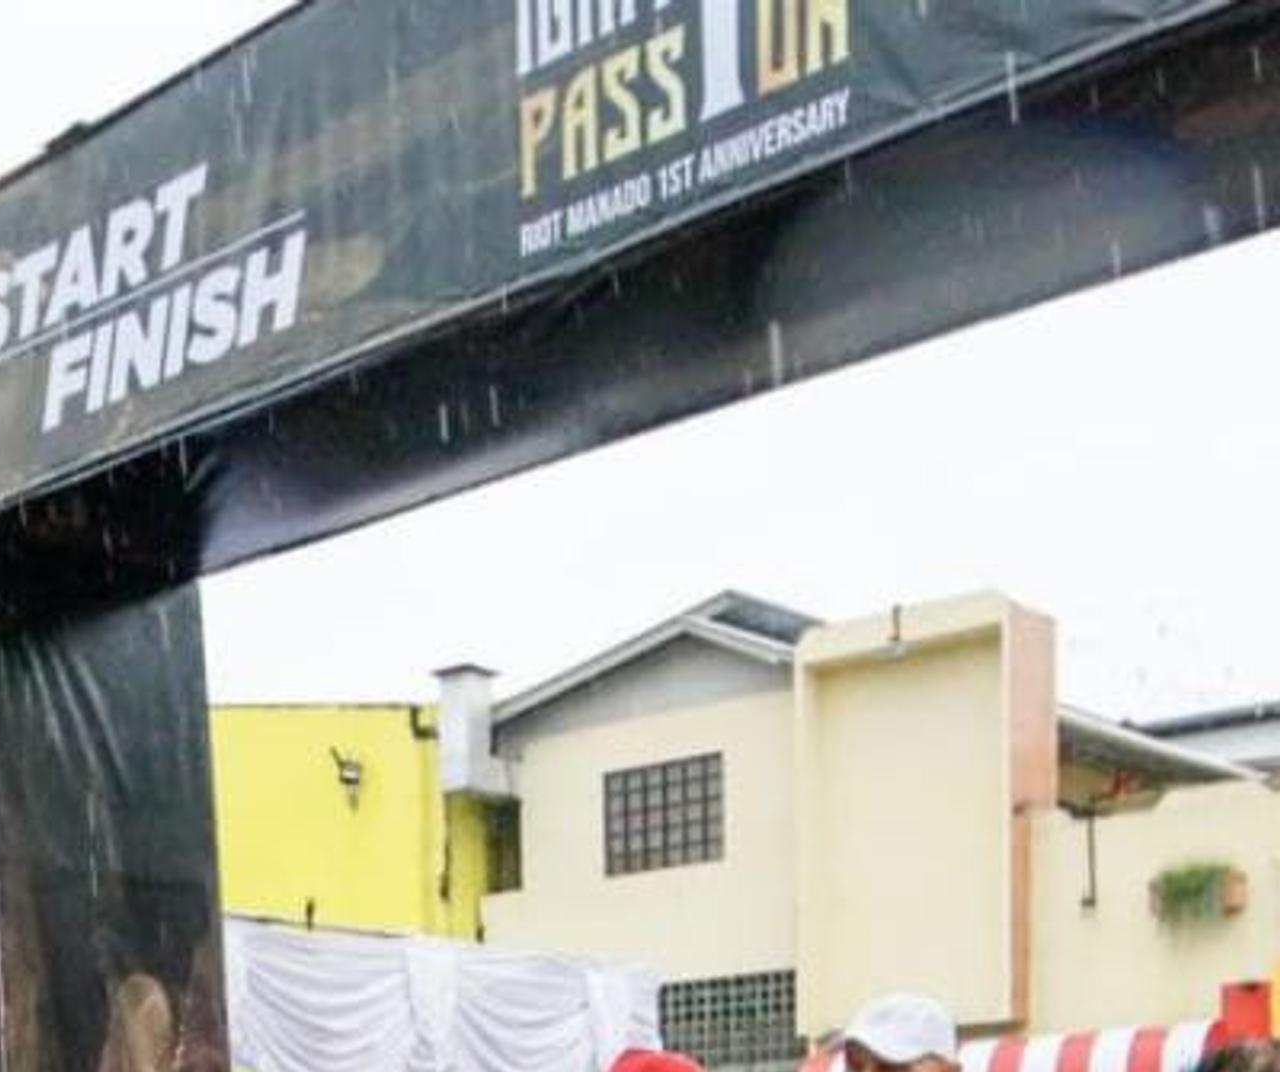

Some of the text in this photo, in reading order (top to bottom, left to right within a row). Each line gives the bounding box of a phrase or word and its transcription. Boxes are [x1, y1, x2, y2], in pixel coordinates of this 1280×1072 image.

[520, 26, 688, 198] PASS
[520, 87, 853, 257] RIOT MANADO 1ST ANNIVERSARY
[42, 229, 307, 434] FINISH
